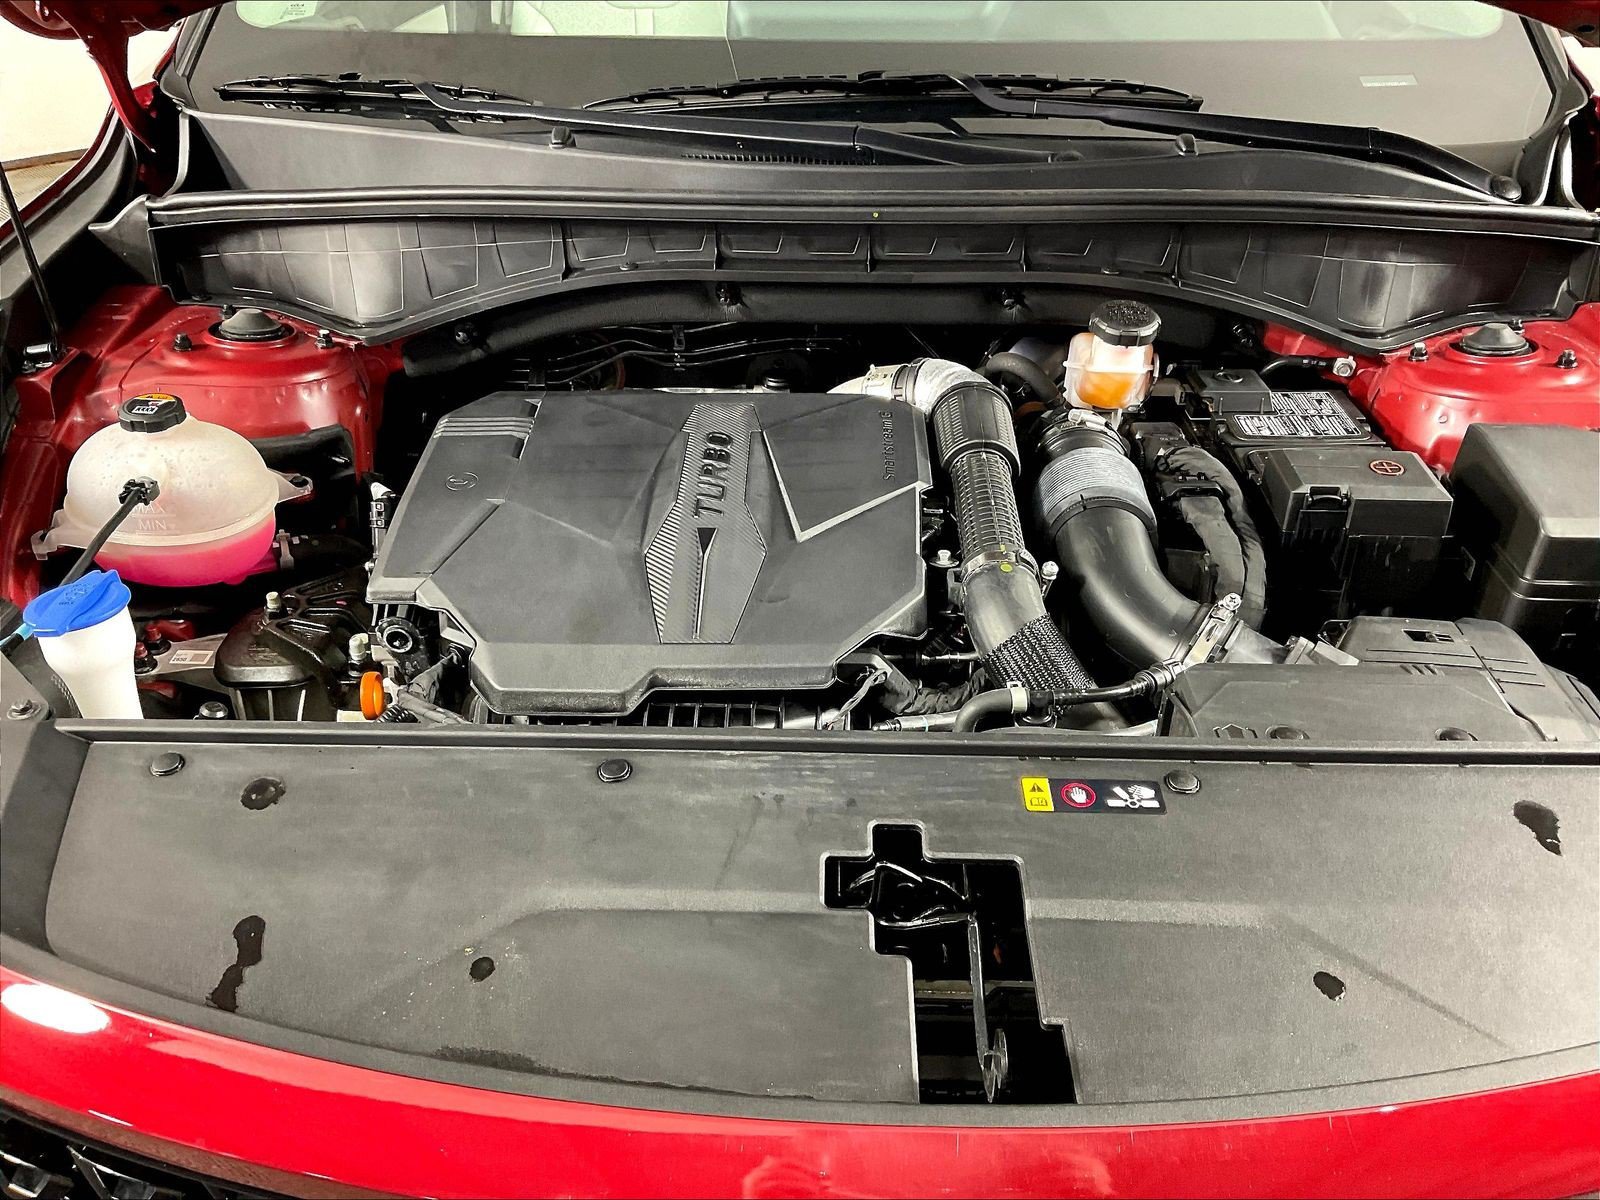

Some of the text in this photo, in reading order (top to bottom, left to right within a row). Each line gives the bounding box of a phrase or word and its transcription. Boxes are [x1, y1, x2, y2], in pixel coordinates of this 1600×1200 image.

[693, 432, 733, 518] TURBO
[882, 420, 895, 481] Smartstream
[139, 519, 167, 530] MIN
